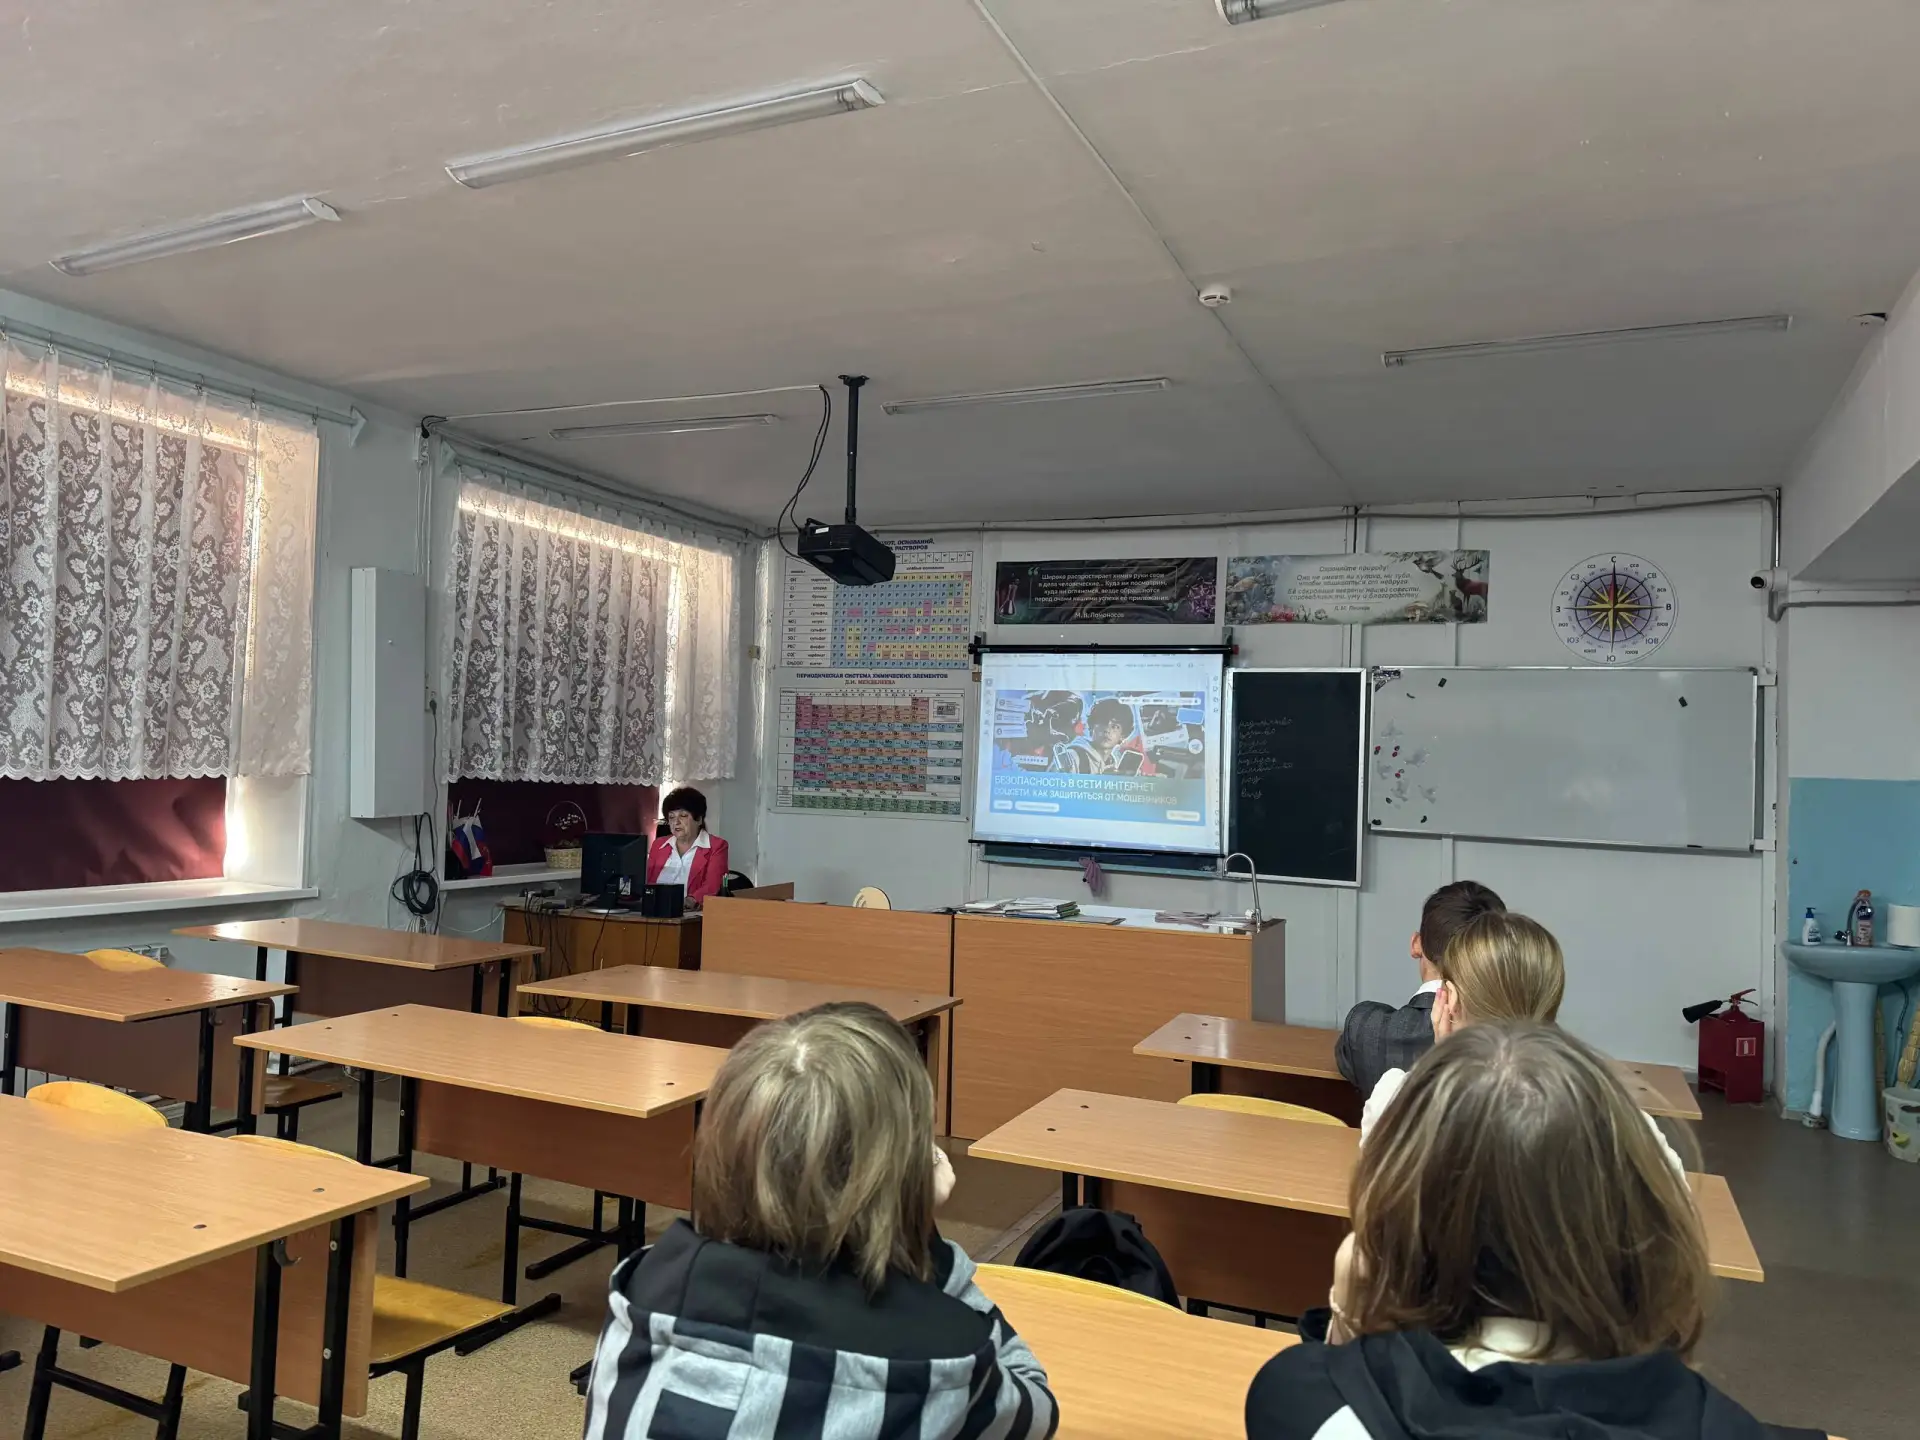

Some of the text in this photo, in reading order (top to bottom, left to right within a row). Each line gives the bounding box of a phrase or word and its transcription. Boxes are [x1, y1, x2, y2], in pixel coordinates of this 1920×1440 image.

[995, 776, 1066, 788] БЕЗОПАСНОСТЬ
[1068, 778, 1074, 788] В
[1077, 780, 1102, 789] СЕТИ
[1050, 790, 1103, 801] ЗАЩИТИТЬСЯ
[1105, 793, 1116, 801] ОТ
[1117, 794, 1177, 805] МОШЕННИКОВ
